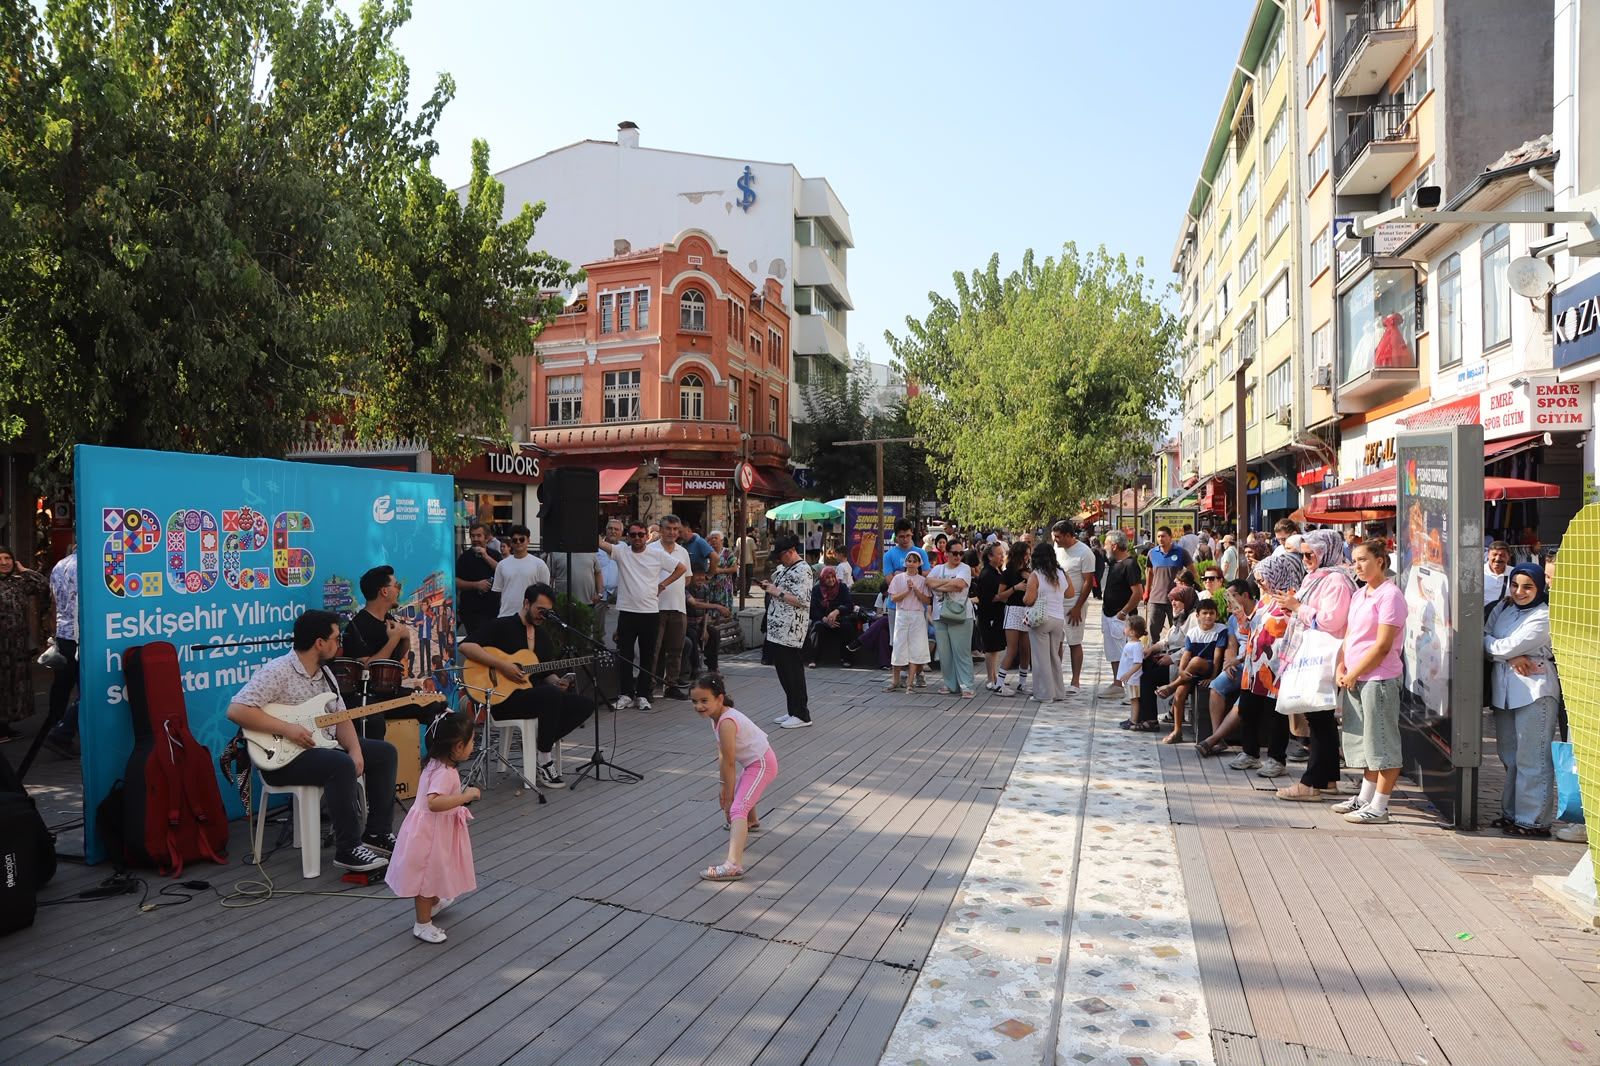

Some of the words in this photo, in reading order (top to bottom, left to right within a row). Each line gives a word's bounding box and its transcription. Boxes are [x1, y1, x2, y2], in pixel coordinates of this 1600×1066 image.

[1536, 384, 1580, 396] EMRE
[1490, 391, 1514, 411] EMRE
[1537, 397, 1579, 408] SPOR
[1484, 415, 1501, 431] SPOR
[1502, 409, 1524, 427] GİYİM
[1536, 411, 1583, 424] GİYİM
[488, 452, 540, 477] TUDORS
[684, 481, 726, 490] NAMSAN
[105, 602, 228, 640] Eskişehir
